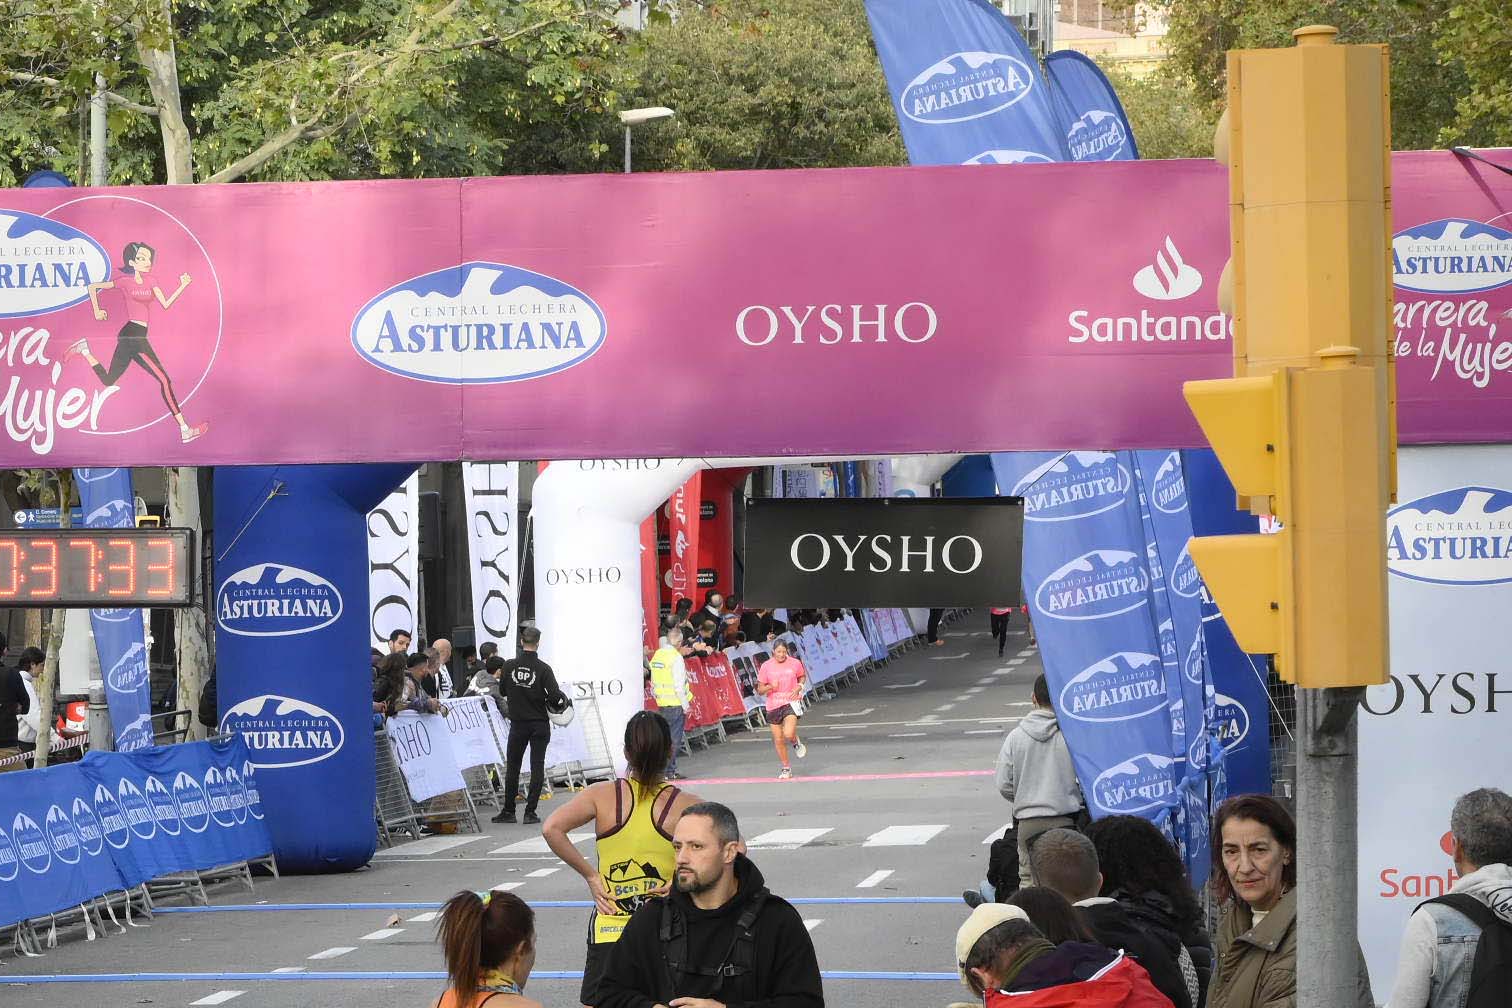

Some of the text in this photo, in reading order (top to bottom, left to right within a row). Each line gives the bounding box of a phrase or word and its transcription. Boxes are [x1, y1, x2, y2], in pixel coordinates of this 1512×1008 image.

[13, 245, 86, 257] LECHERA
[410, 303, 577, 318] CENTRAL LECHERA
[1392, 299, 1489, 328] arrera
[371, 309, 586, 353] ASTURIANA
[735, 301, 938, 346] OYSHO
[1068, 309, 1234, 344] Santand
[1417, 323, 1512, 388] la Muje
[1415, 519, 1482, 532] CENTRAL
[790, 533, 983, 574] OYSHO
[545, 566, 621, 586] OYSHO
[233, 587, 329, 597] CENTRAL LECHERA
[221, 593, 334, 620] ASTURIANA
[517, 671, 530, 681] BP
[235, 718, 330, 728] CENTRAL LECHERA
